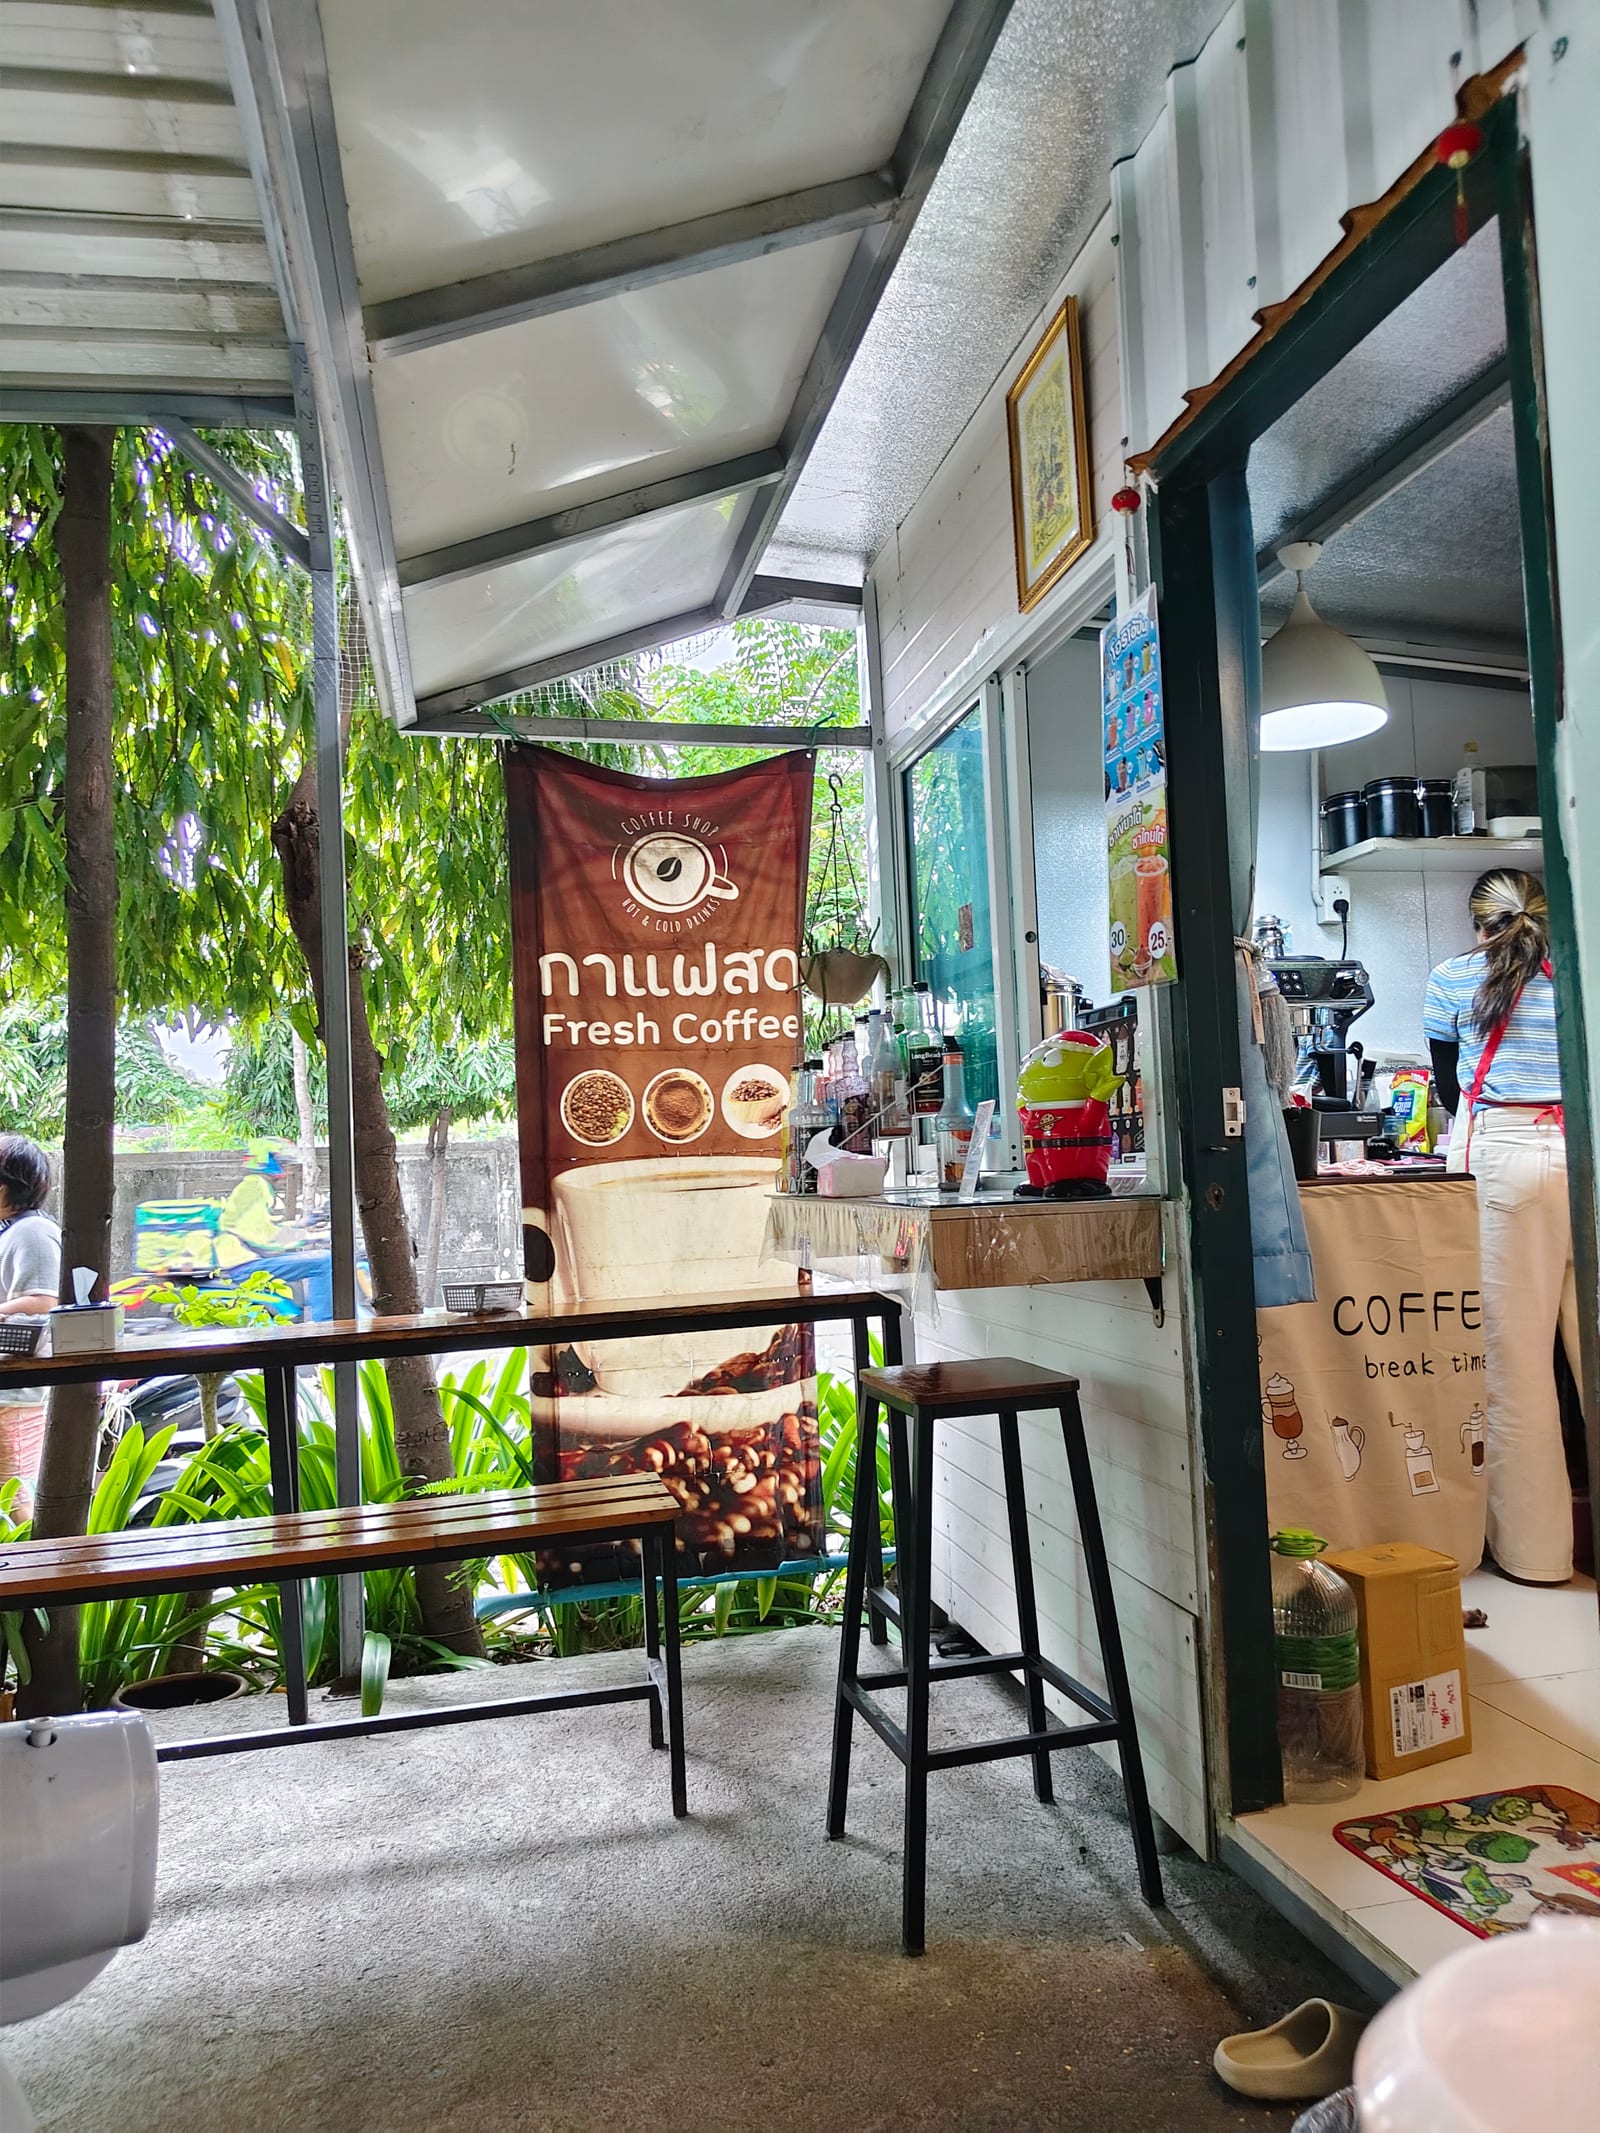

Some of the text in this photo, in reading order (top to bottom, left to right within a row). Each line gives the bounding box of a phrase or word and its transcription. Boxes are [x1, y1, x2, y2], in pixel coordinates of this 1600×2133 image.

[620, 810, 720, 837] COFFEE SHOP
[621, 897, 721, 933] HOT & COLD DRINKS
[538, 942, 799, 997] กาแฟสด
[543, 1008, 799, 1046] Fresh Coffee
[1365, 1352, 1487, 1379] break time
